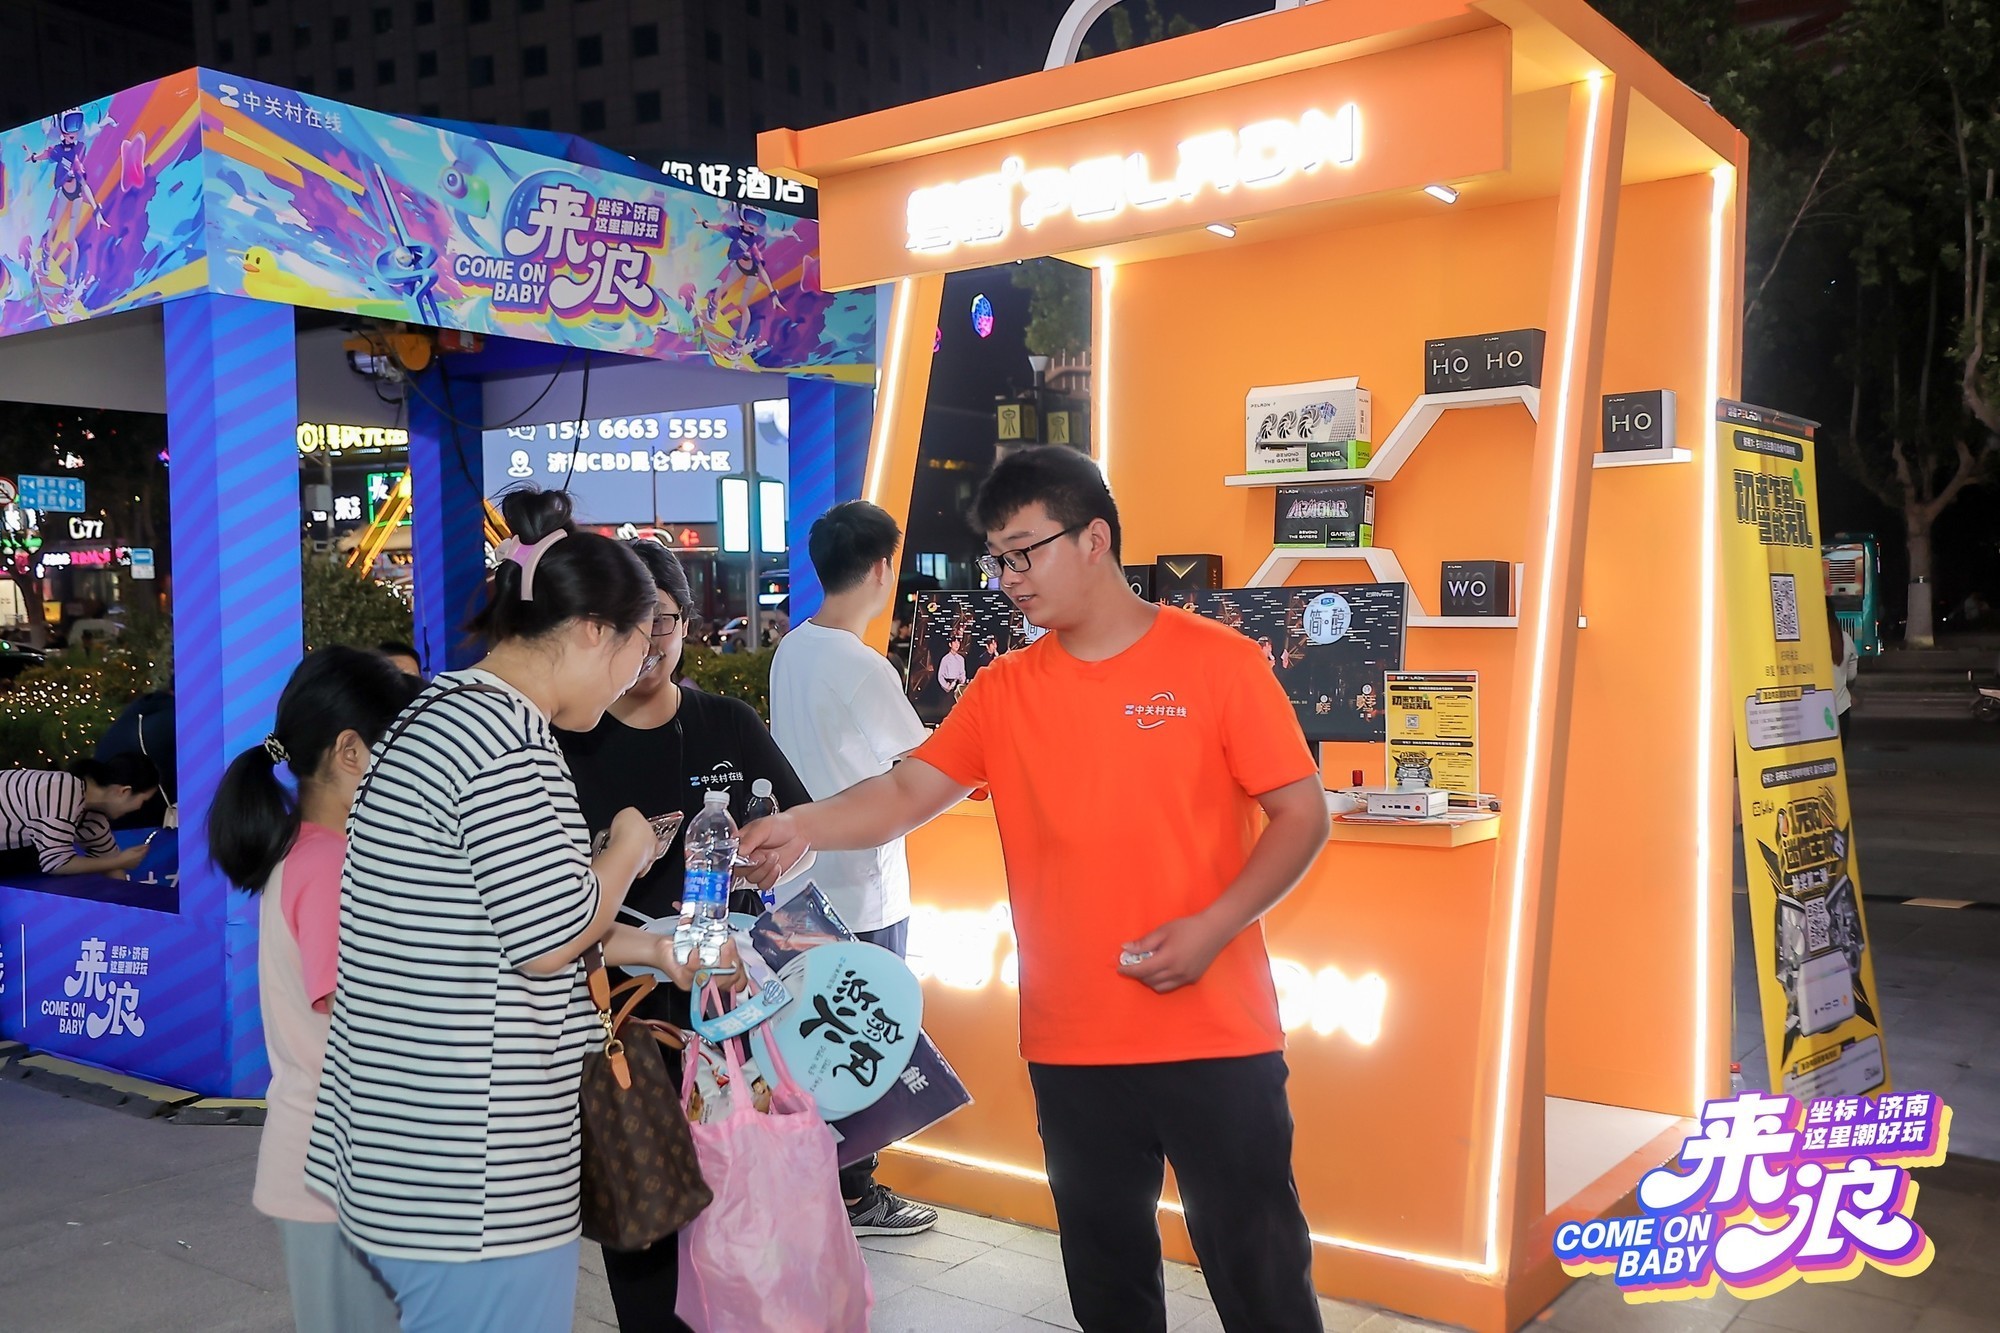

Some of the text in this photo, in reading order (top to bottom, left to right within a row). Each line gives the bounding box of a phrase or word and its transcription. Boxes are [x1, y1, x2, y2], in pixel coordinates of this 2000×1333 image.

[242, 92, 342, 133] 中关村在线
[633, 204, 660, 222] 济南
[594, 217, 659, 239] 这里潮好玩
[455, 256, 547, 284] COME ON
[493, 282, 546, 304] BABY
[1432, 356, 1469, 375] HO
[1487, 350, 1523, 370] HO
[598, 418, 659, 440] 6663
[668, 418, 728, 440] 5555
[1611, 412, 1652, 432] HO
[1310, 450, 1341, 459] GAMING
[1447, 580, 1486, 597] WO
[1135, 705, 1187, 717] 中关村在线
[701, 772, 744, 785] 中关村在线
[133, 946, 149, 961] 济南
[41, 1000, 85, 1018] COME ON
[59, 1018, 85, 1035] BABY
